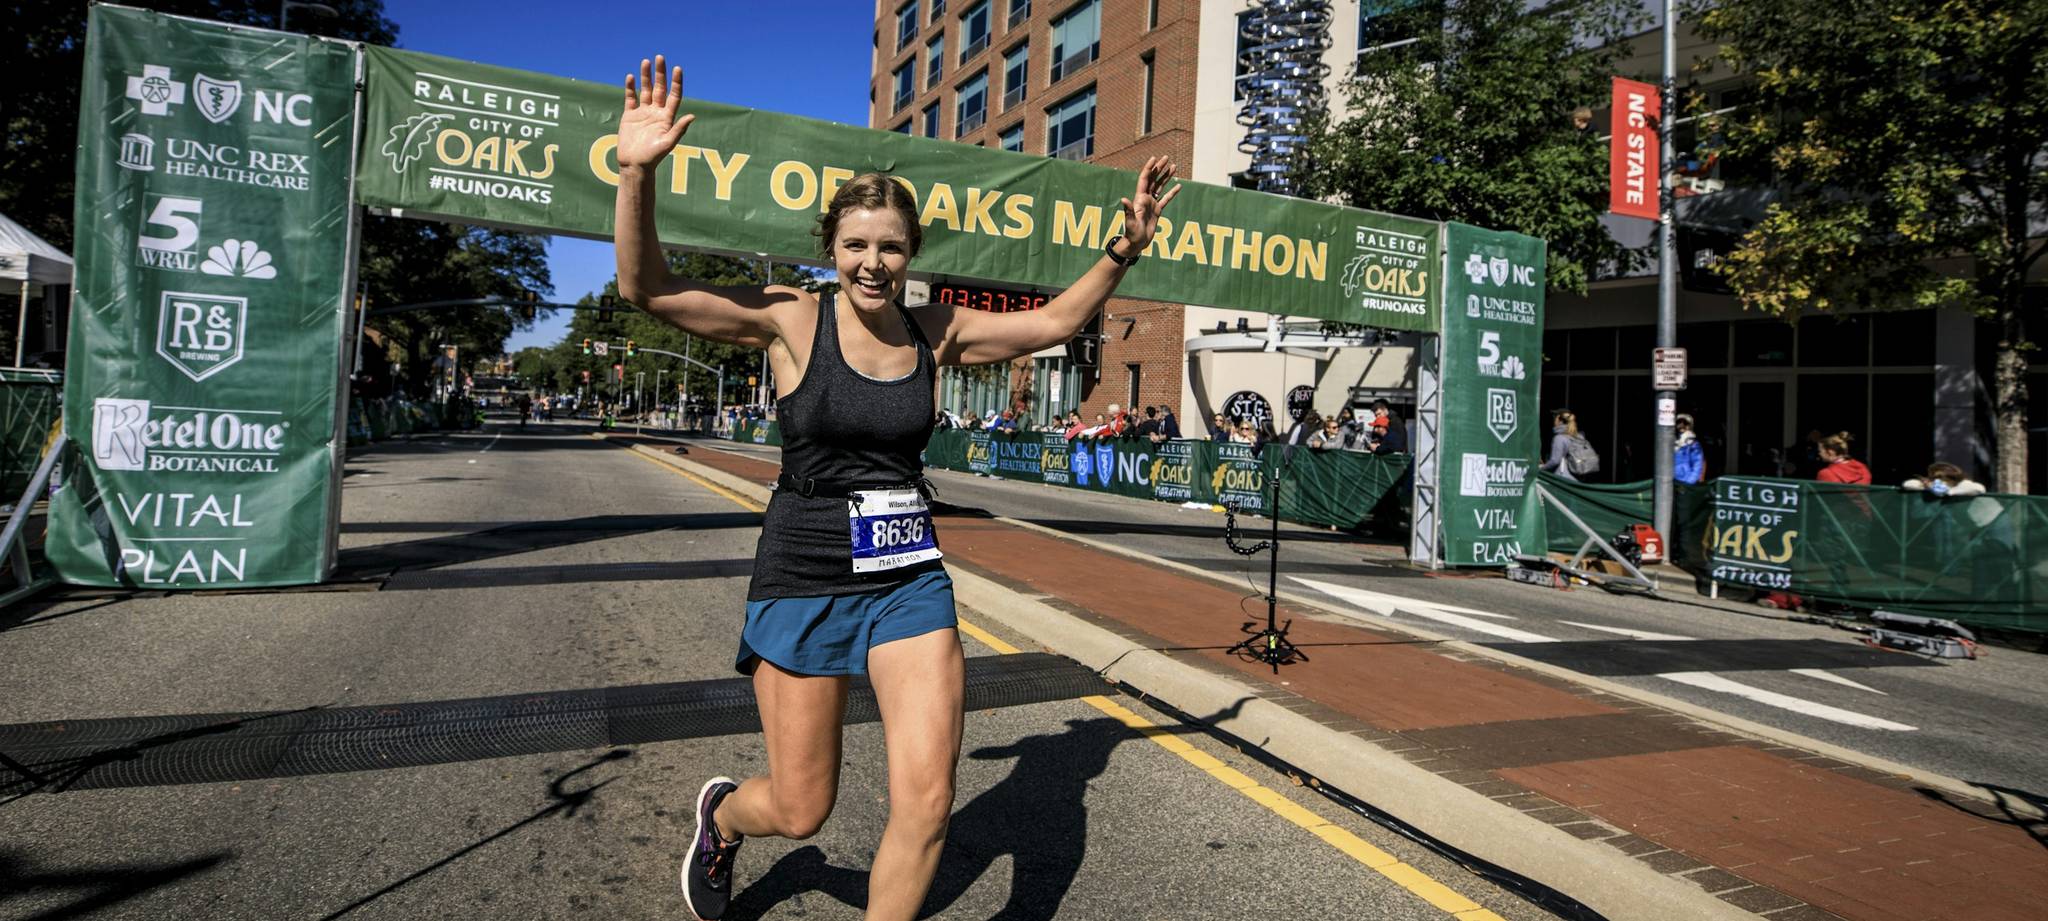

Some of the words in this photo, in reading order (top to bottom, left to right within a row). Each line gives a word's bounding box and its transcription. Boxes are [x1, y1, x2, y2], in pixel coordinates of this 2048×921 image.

[253, 90, 313, 127] NC
[415, 80, 560, 119] RALEIGH
[1628, 92, 1646, 129] NC
[469, 117, 513, 135] CITY
[520, 125, 544, 139] OF
[166, 137, 240, 166] UNC
[248, 149, 311, 175] REX
[435, 128, 560, 180] OAKS
[165, 160, 310, 191] HEALTHCARE
[1626, 132, 1646, 206] STATE
[429, 174, 552, 204] #RUNOAKS
[588, 133, 751, 201] CTY
[769, 160, 856, 214] OF
[888, 174, 1035, 240] AKS
[1052, 199, 1328, 281] MARATHON
[138, 196, 203, 252] 5
[1356, 231, 1427, 255] RALEIGH
[140, 248, 197, 271] WRAL
[1382, 255, 1405, 267] CITY
[1406, 258, 1419, 269] OF
[1365, 264, 1428, 297] OAKS
[1513, 263, 1536, 287] NC
[1362, 298, 1427, 315] #RUNOAKS
[1483, 296, 1511, 312] UNC
[1512, 300, 1536, 315] REX
[1483, 310, 1536, 326] HEALTHCARE
[179, 351, 221, 363] BREWING
[1477, 331, 1501, 365] 5
[95, 402, 209, 467] Ketel
[1000, 442, 1020, 458] UNC
[1022, 443, 1041, 460] REX
[1159, 444, 1192, 454] ALEIGH
[149, 455, 279, 473] BOTANICAL
[1119, 452, 1149, 485] NC
[1160, 465, 1192, 485] OAKS
[1226, 469, 1264, 491] OAKS
[117, 492, 254, 528] VITAL
[1473, 508, 1518, 530] VITAL
[1715, 509, 1754, 523] CITY
[1759, 514, 1783, 526] OF
[872, 516, 925, 549] 8636
[114, 547, 248, 584] PLAN
[1472, 541, 1522, 564] PLAN
